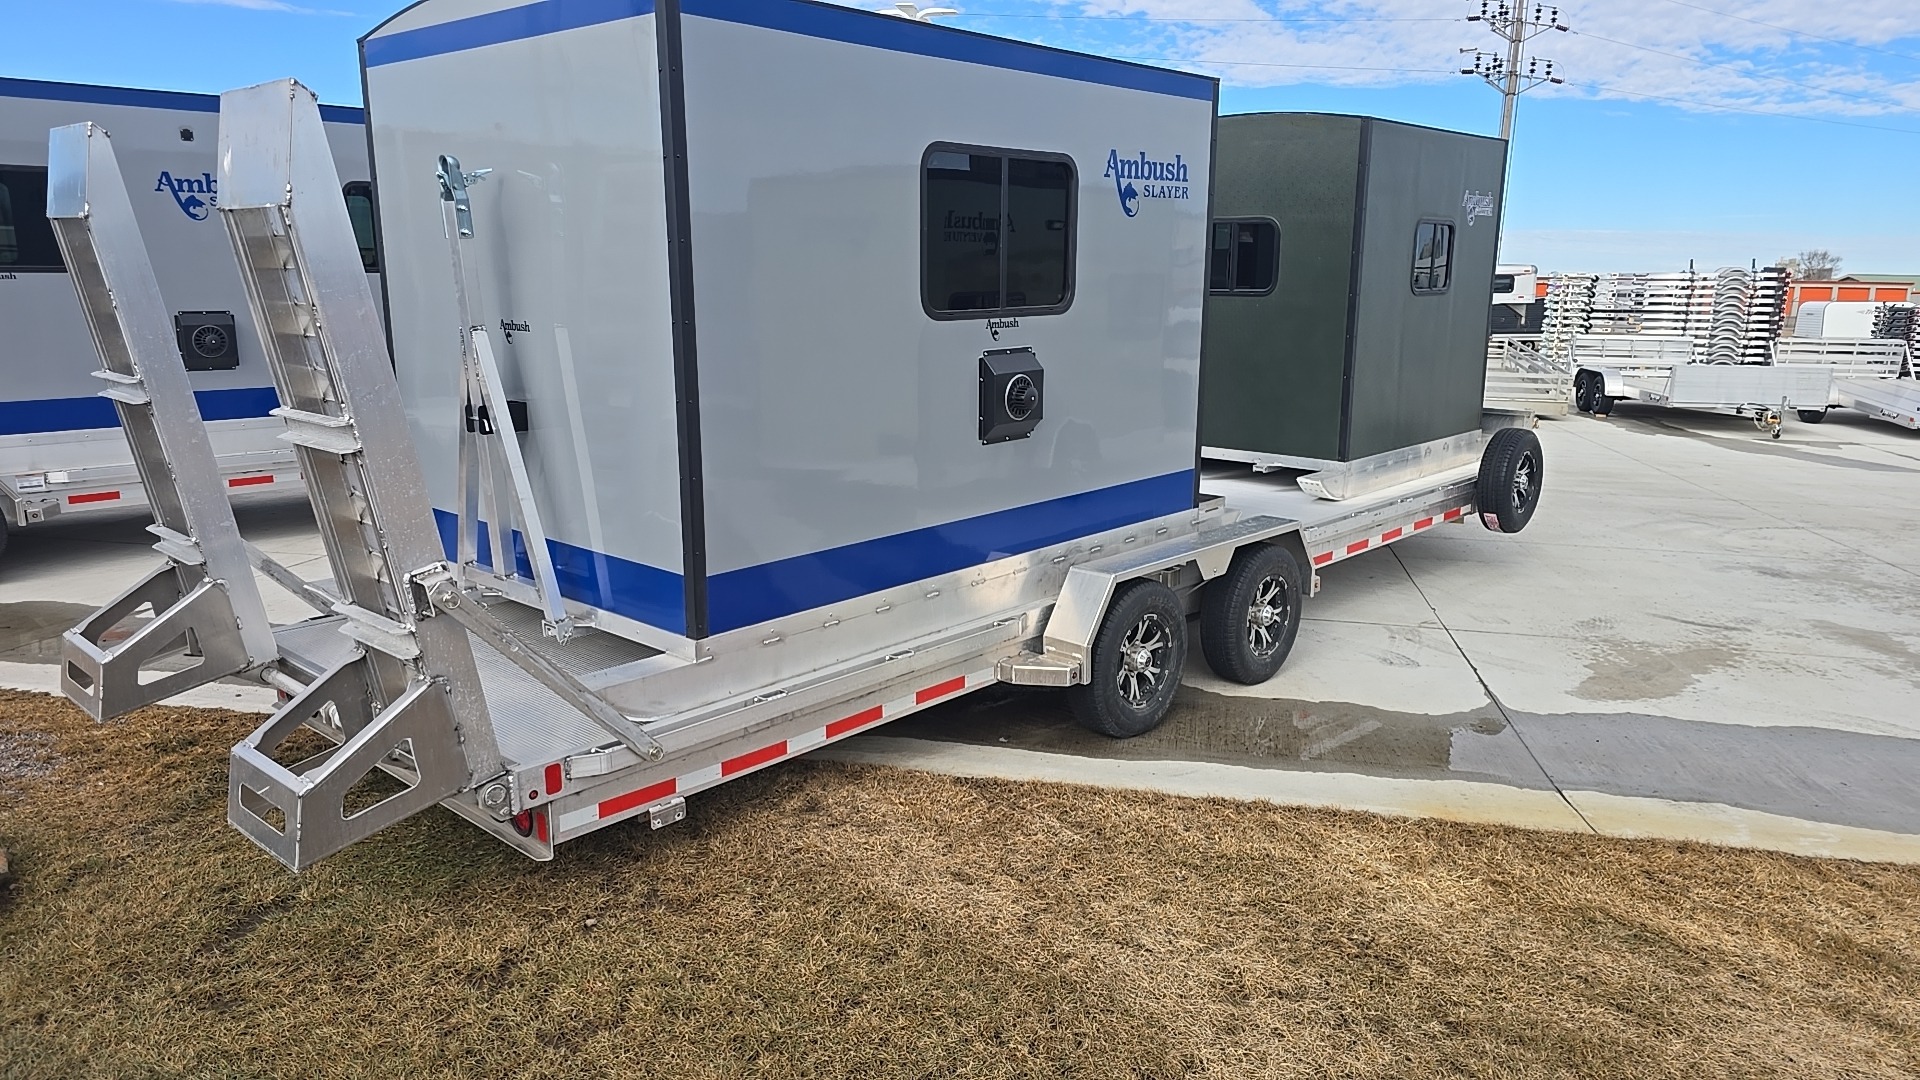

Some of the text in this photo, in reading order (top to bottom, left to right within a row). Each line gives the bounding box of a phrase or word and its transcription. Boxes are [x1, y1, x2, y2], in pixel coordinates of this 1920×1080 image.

[1104, 149, 1188, 198] Ambush
[155, 171, 217, 206] Amb
[1144, 184, 1188, 200] SLAYER
[500, 319, 530, 337] Ambush
[986, 317, 1019, 335] Ambush
